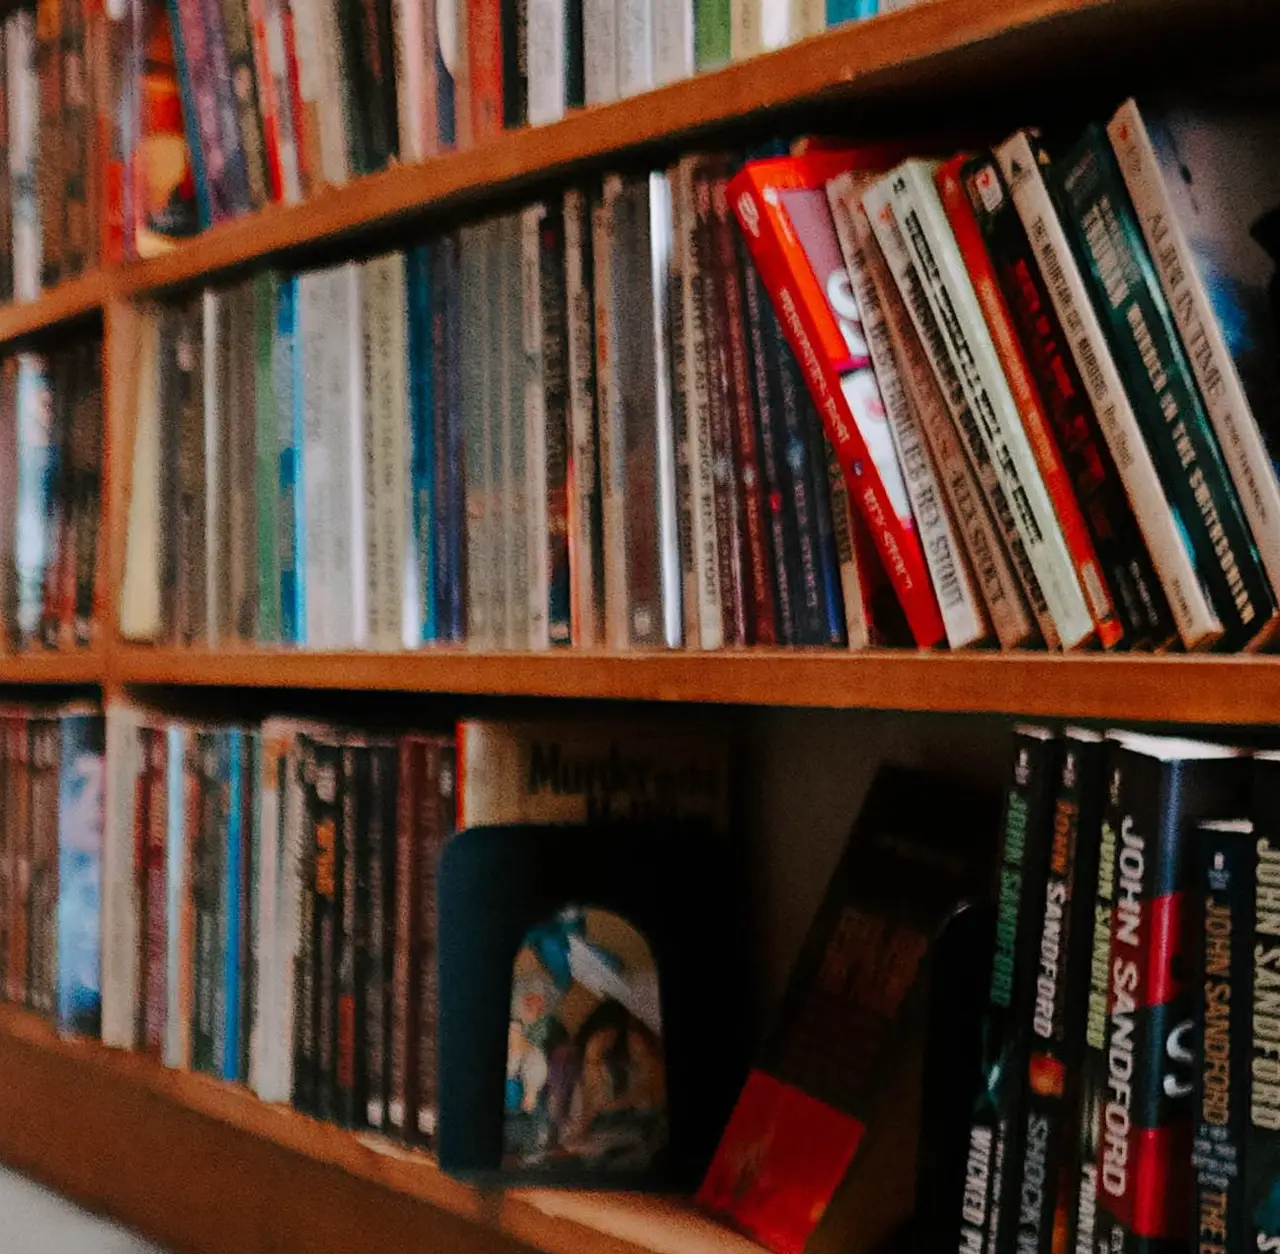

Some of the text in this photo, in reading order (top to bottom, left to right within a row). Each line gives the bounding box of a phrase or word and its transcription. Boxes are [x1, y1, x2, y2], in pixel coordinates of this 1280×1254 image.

[1189, 321, 1226, 400] TIME
[928, 534, 964, 608] STOUT
[1172, 420, 1196, 469] THE
[1190, 467, 1255, 625] SMITHSONIAN
[990, 789, 1029, 1008] JOHN SANDFORD
[1033, 877, 1067, 1039] SANDFORD
[1086, 902, 1112, 1051] SANDFORD
[1102, 814, 1146, 1198] JOHN SANDFORD
[1202, 893, 1233, 1126] JOHN SANDFORD
[1250, 836, 1280, 1131] JOHN SANDFORD
[961, 1124, 993, 1227] WICKED
[1018, 1109, 1049, 1227] SHOCK
[1199, 1190, 1228, 1243] THE
